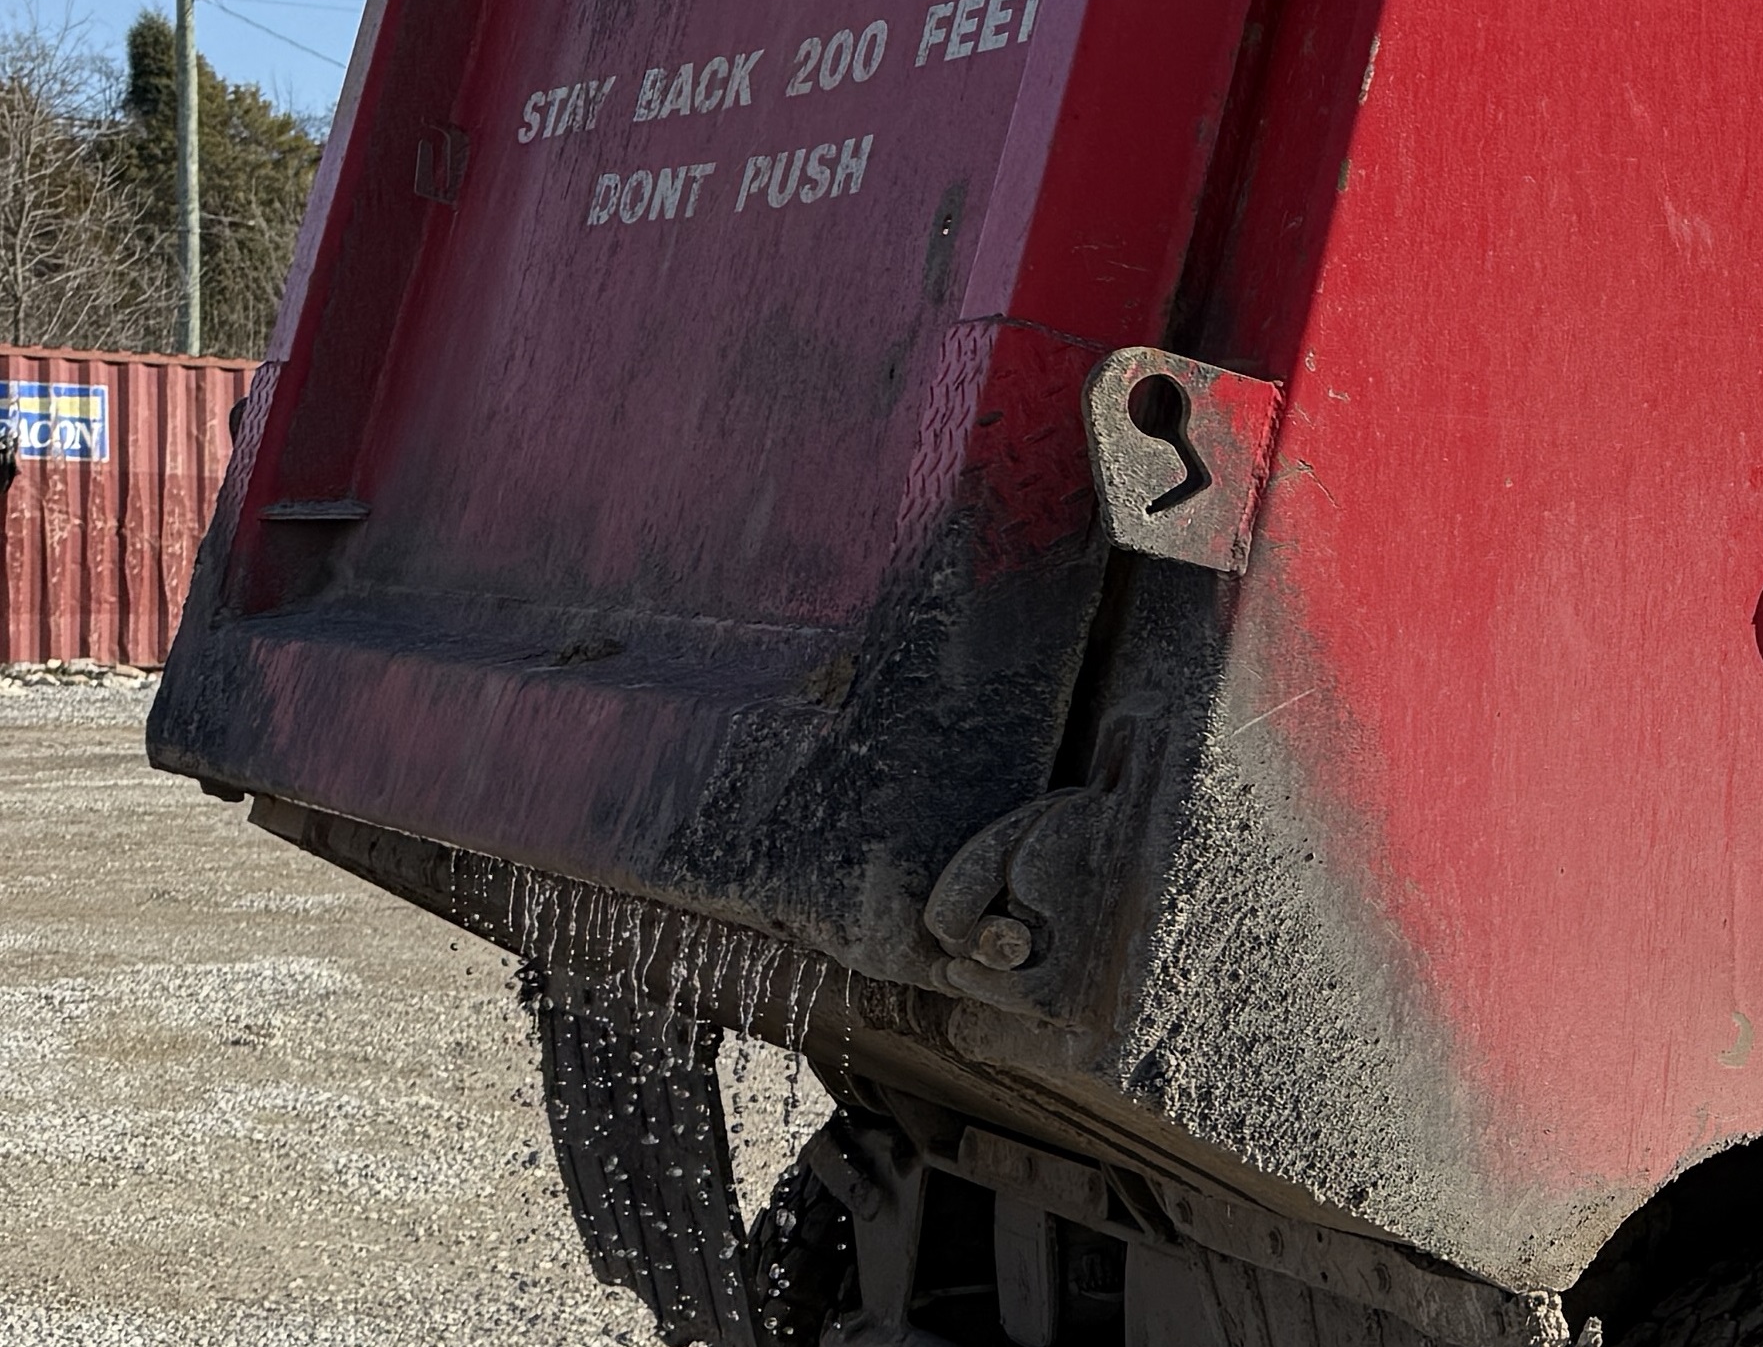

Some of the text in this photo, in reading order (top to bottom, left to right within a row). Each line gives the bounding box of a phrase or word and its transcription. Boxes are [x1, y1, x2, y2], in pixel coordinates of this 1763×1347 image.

[518, 77, 616, 143] STAY
[633, 49, 765, 122] BACK
[785, 19, 888, 97] 200
[586, 134, 875, 226] DONT PUSH
